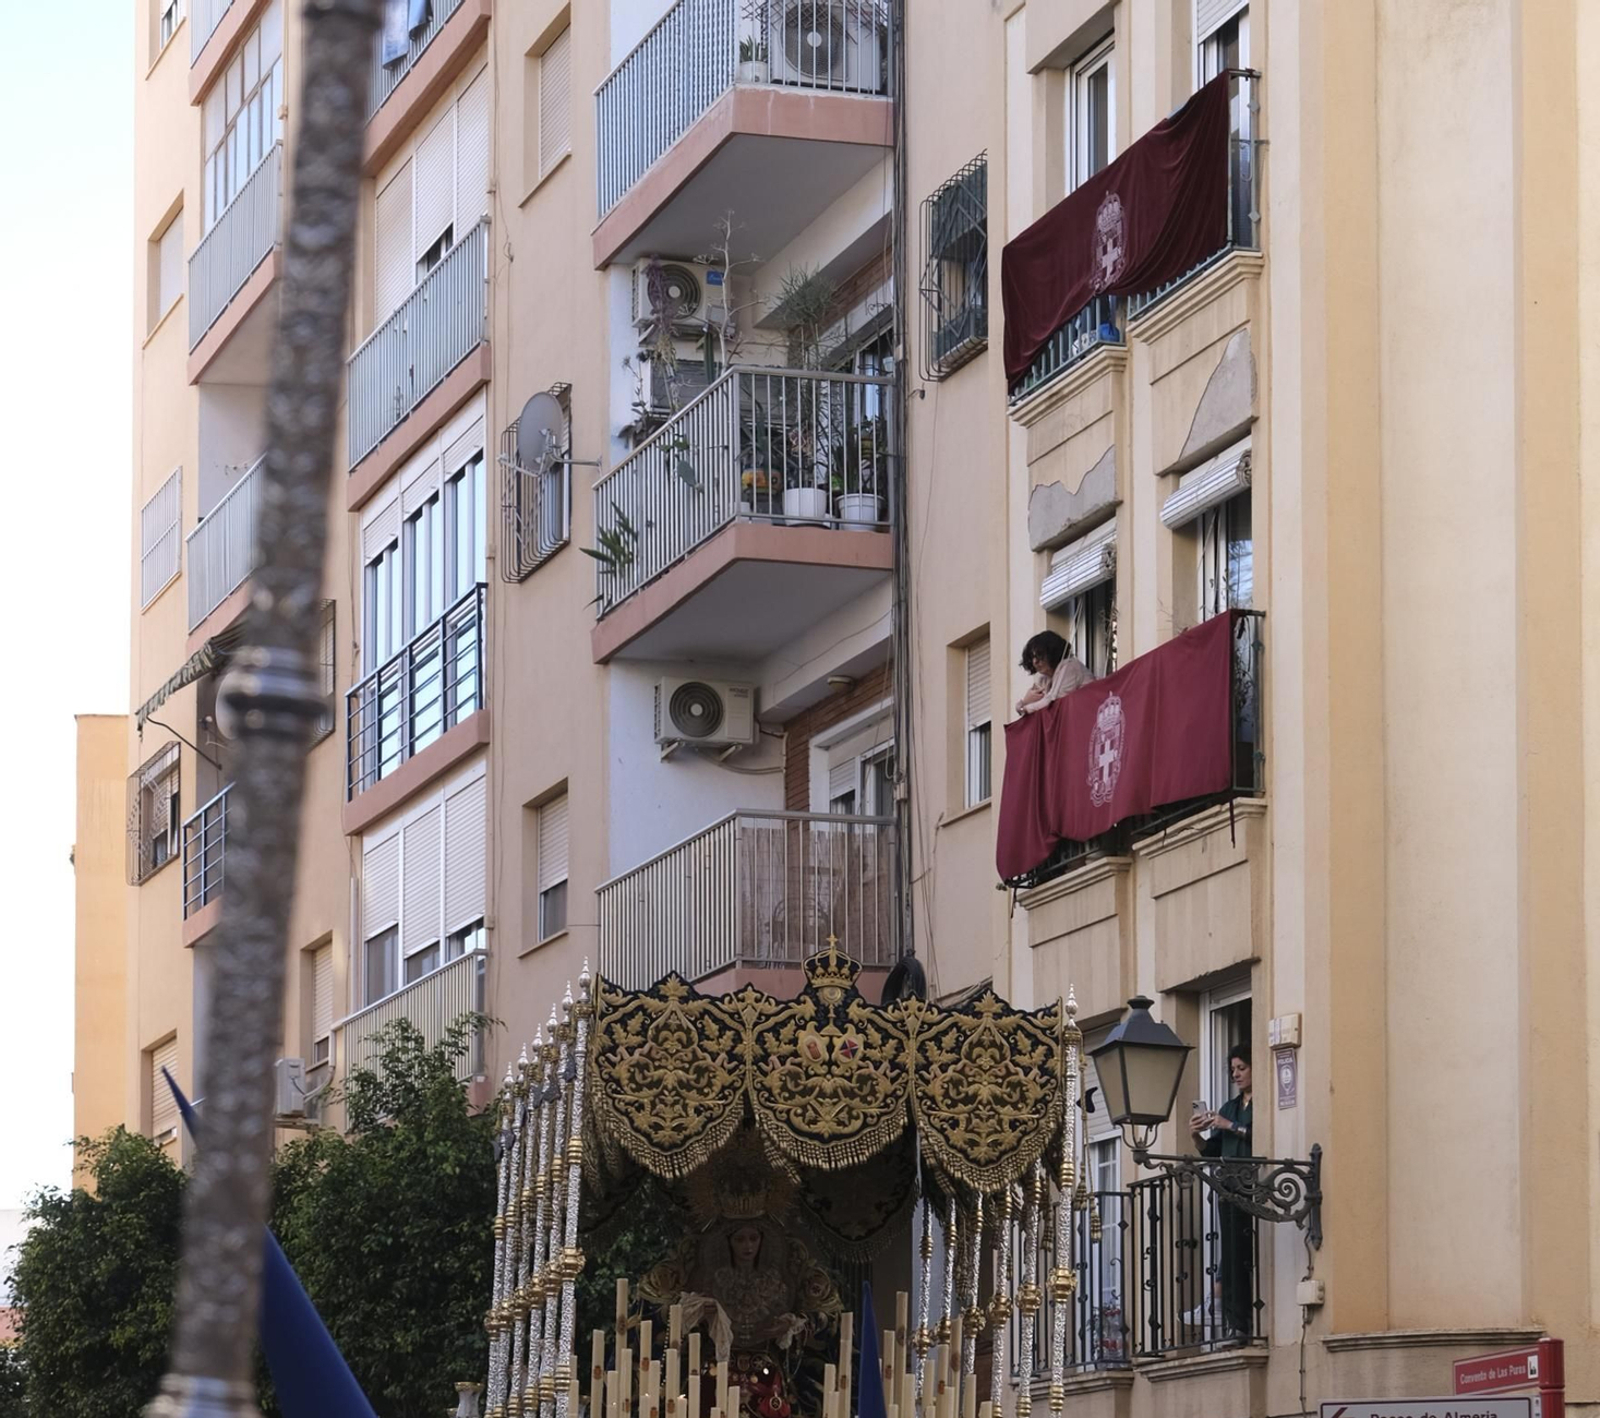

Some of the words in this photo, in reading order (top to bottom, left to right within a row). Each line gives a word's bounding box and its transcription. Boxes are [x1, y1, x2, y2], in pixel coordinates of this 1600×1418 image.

[1460, 1371, 1487, 1384] Convento
[1488, 1368, 1496, 1379] de
[1497, 1367, 1508, 1378] Las
[1508, 1365, 1526, 1376] Puras
